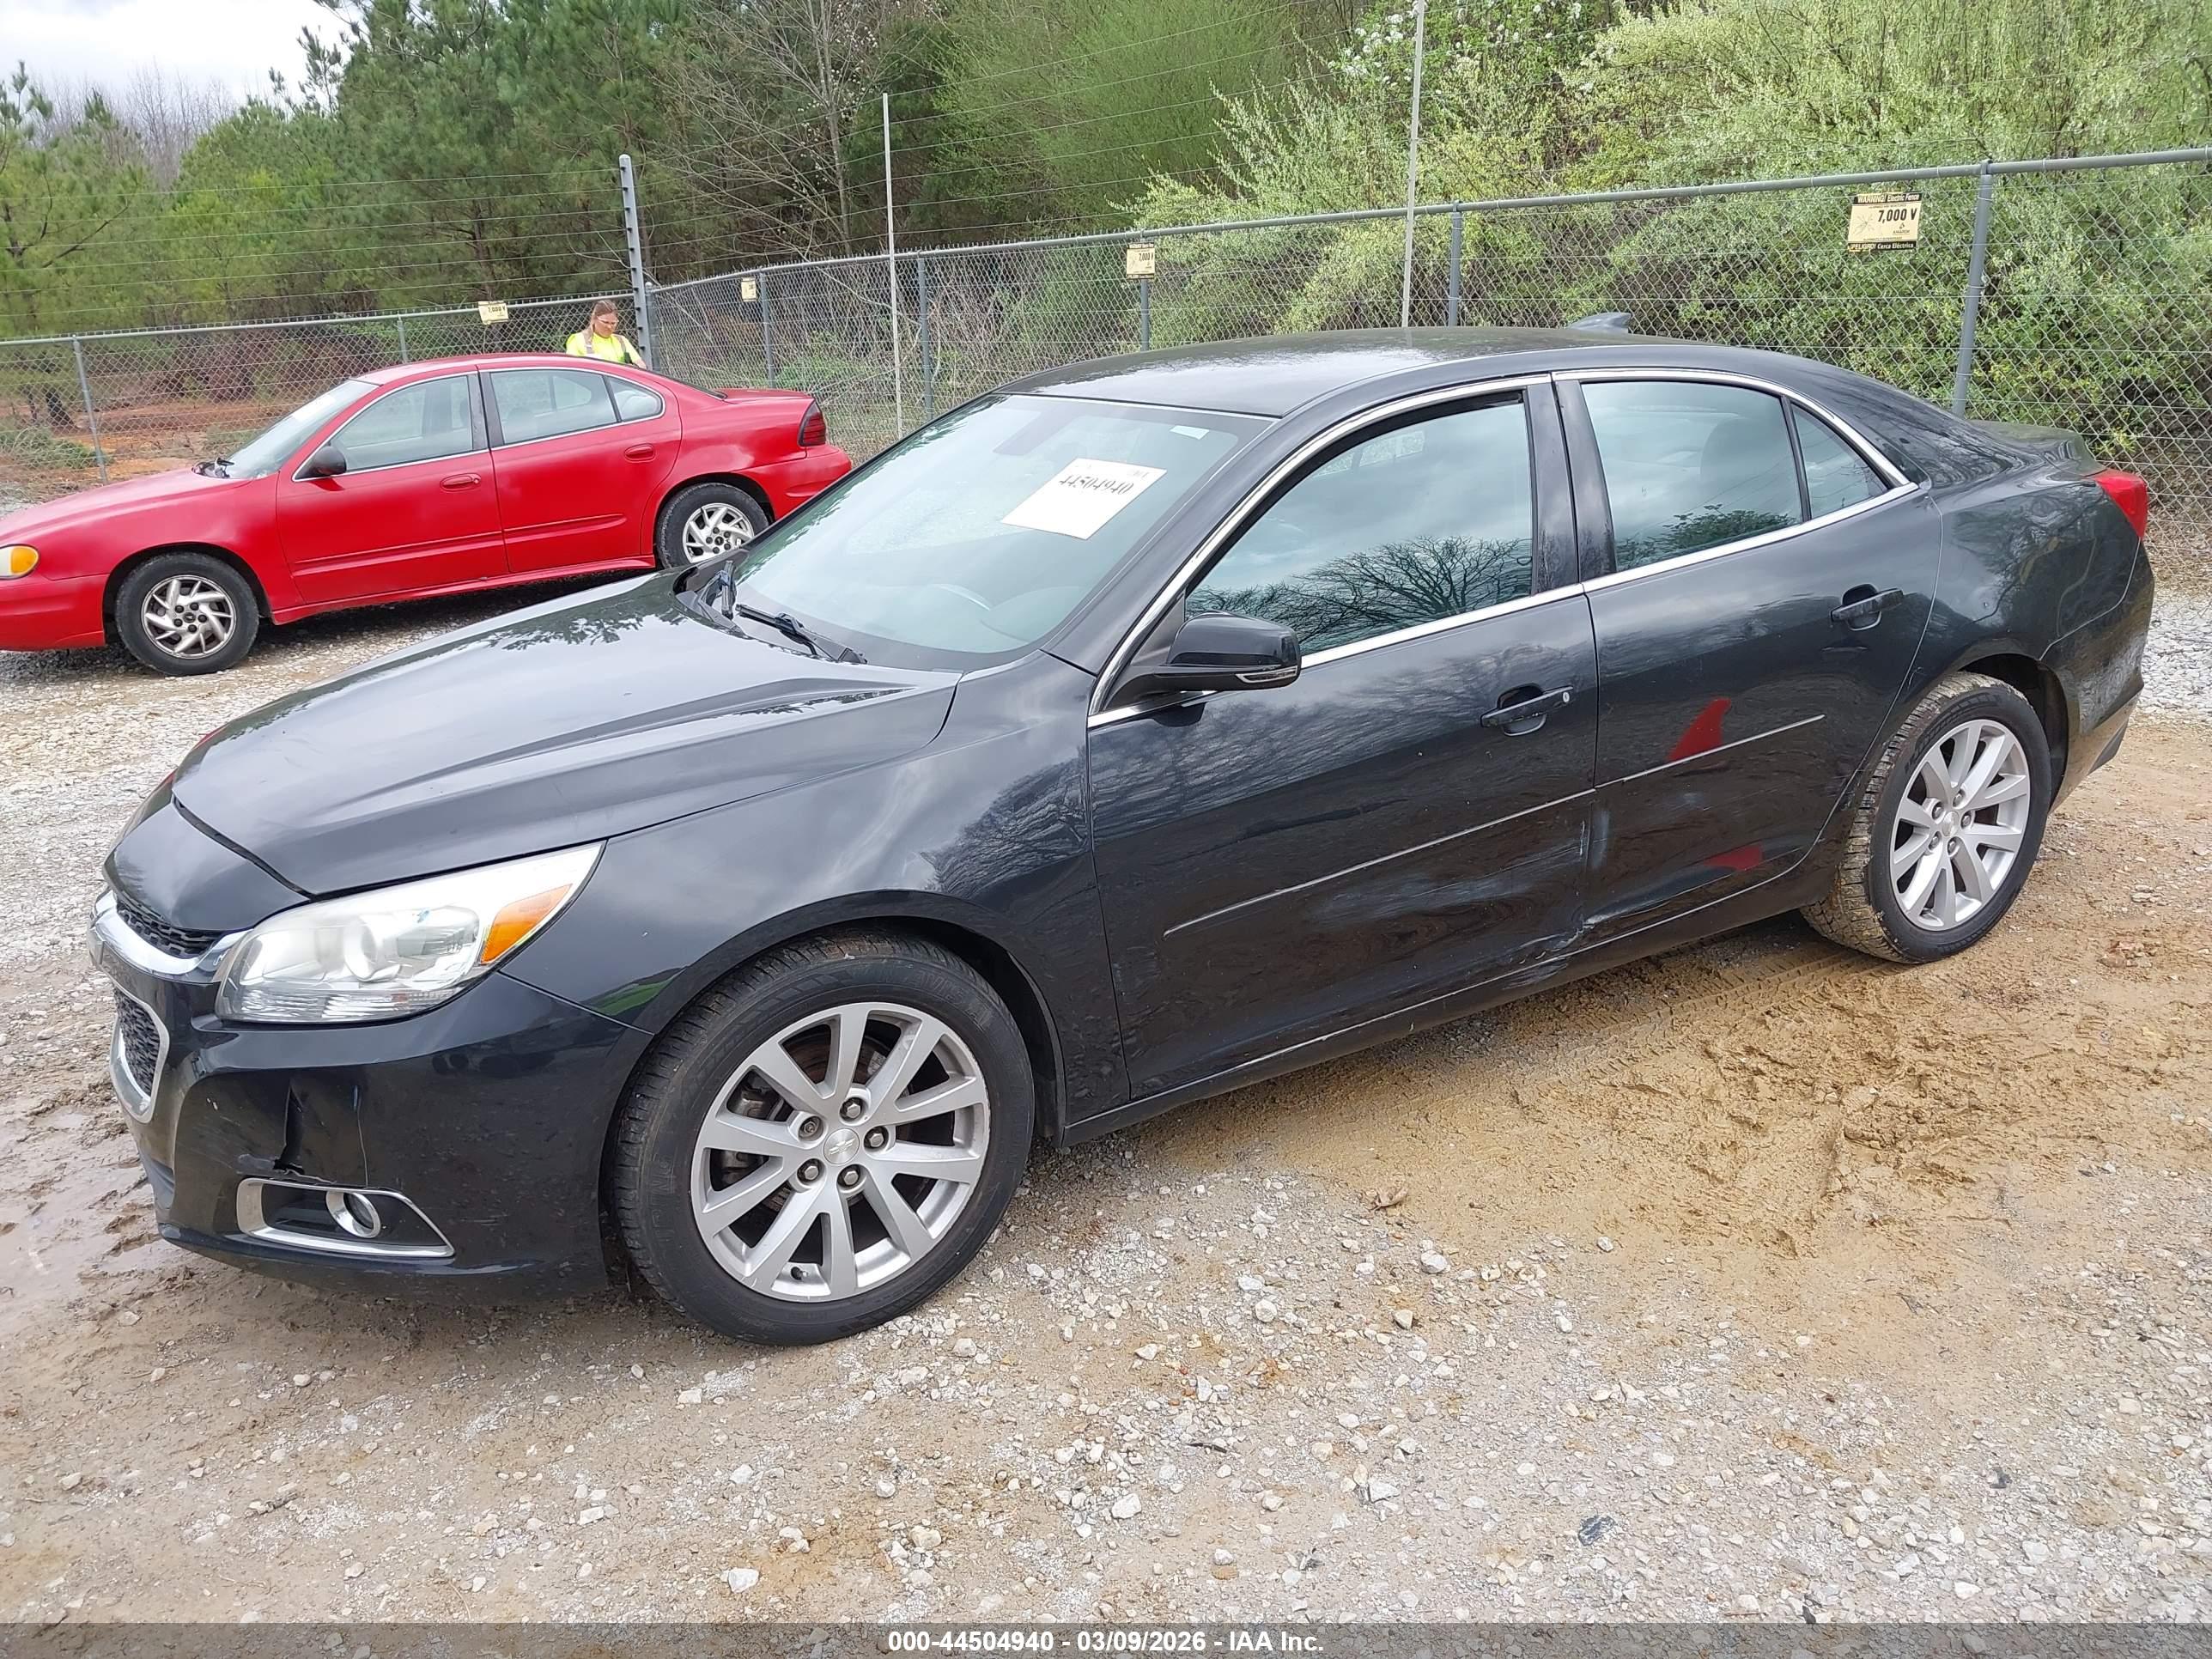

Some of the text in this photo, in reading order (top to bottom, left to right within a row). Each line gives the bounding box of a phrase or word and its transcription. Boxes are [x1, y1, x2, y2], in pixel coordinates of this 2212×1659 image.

[1878, 208, 1917, 223] 7,000 V
[1059, 474, 1134, 495] 44504940
